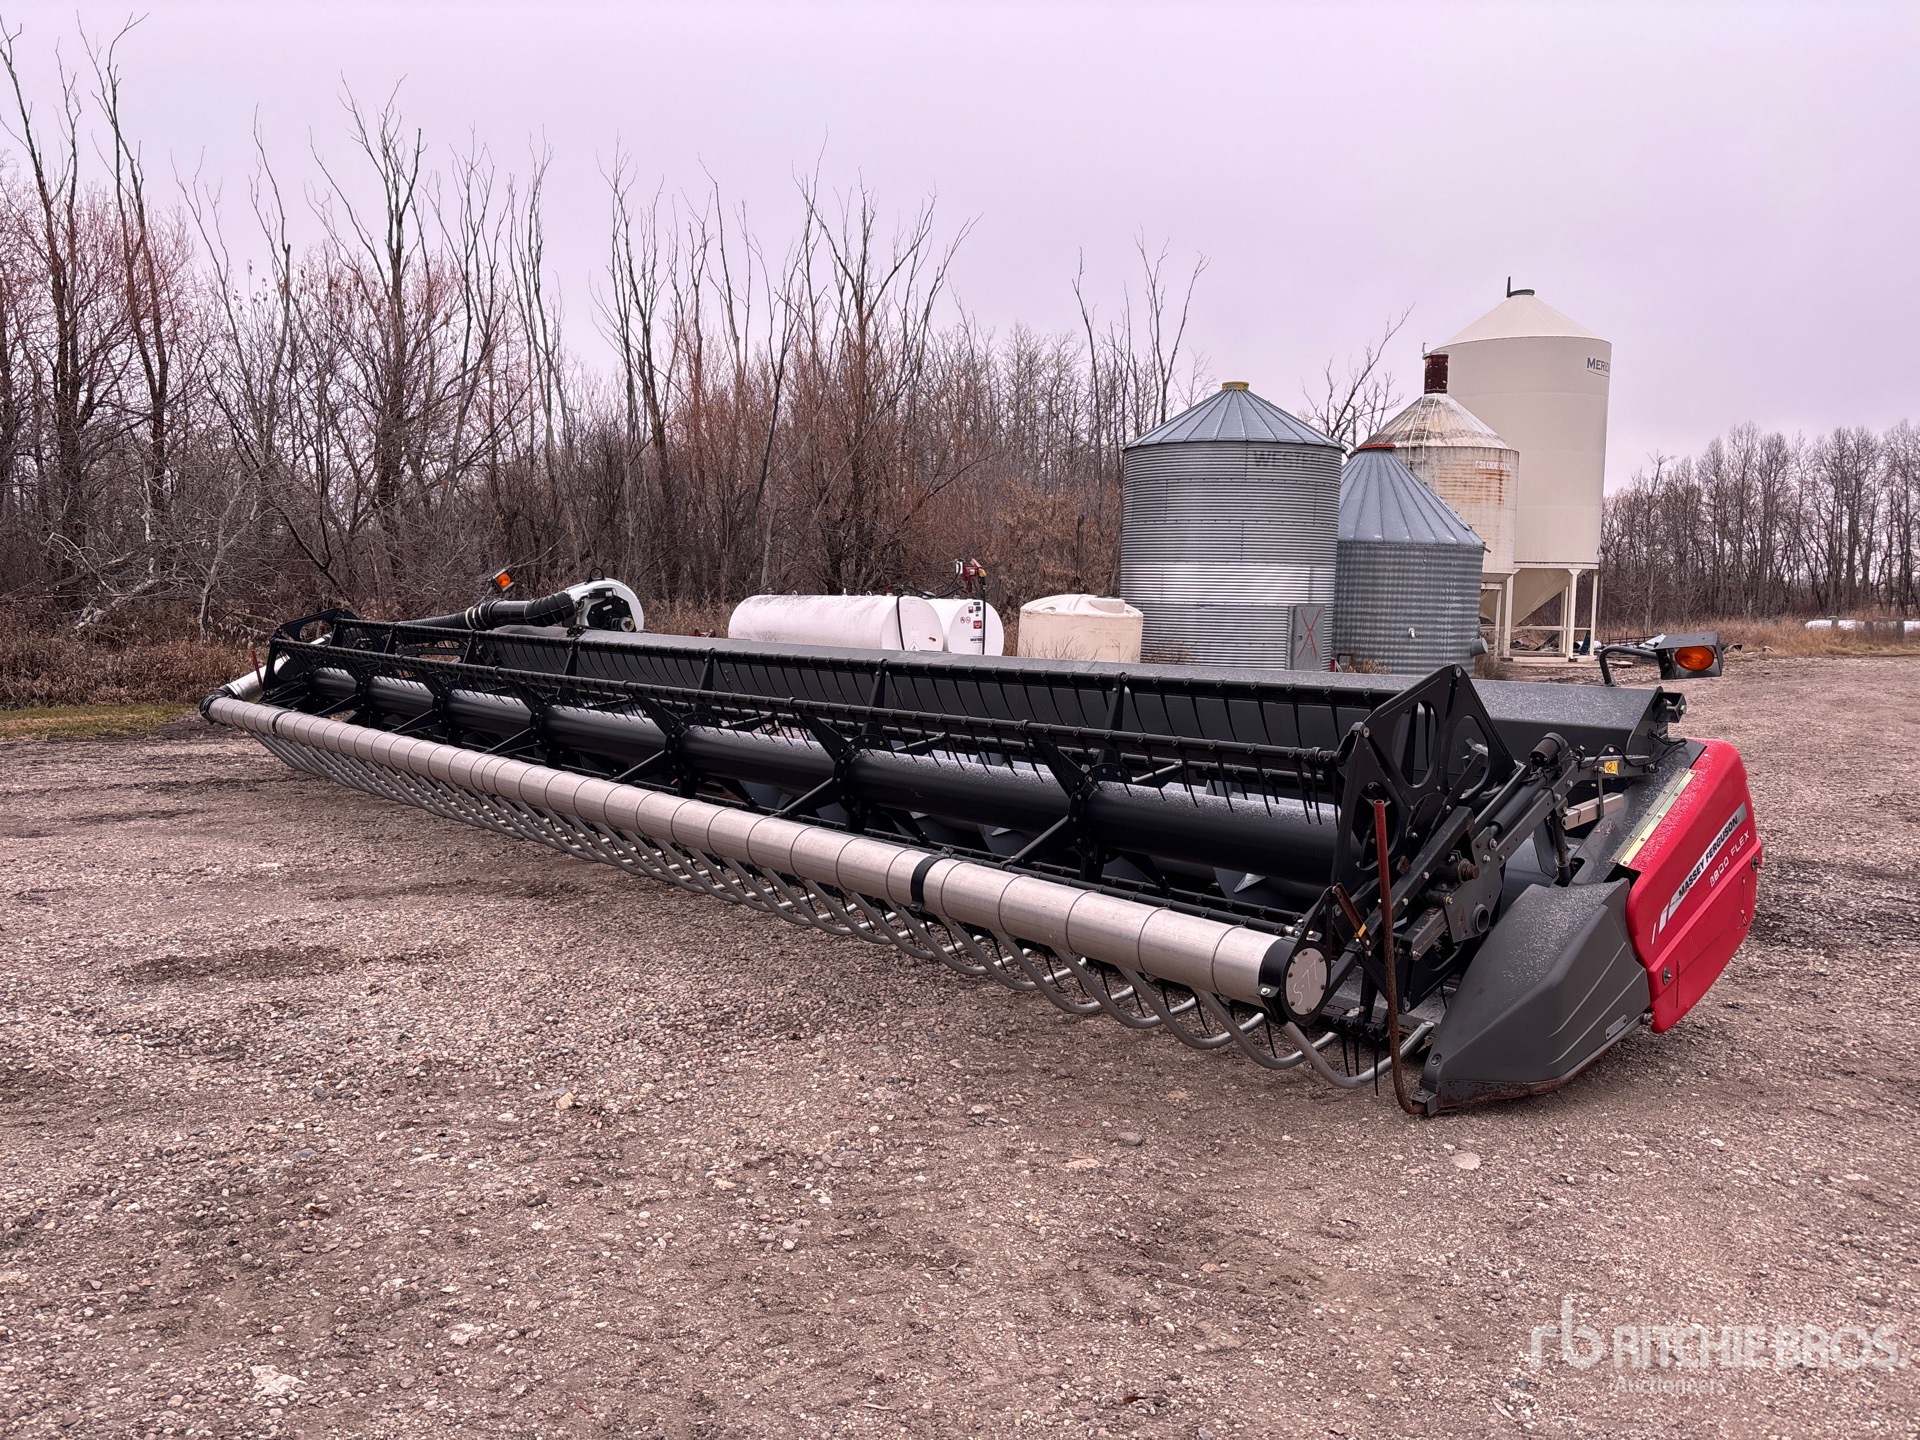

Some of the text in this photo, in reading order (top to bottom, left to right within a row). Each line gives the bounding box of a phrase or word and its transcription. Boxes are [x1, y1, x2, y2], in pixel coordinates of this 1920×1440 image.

[1678, 815, 1738, 898] MASSEY FERGUSON
[1730, 829, 1750, 857] FLEX
